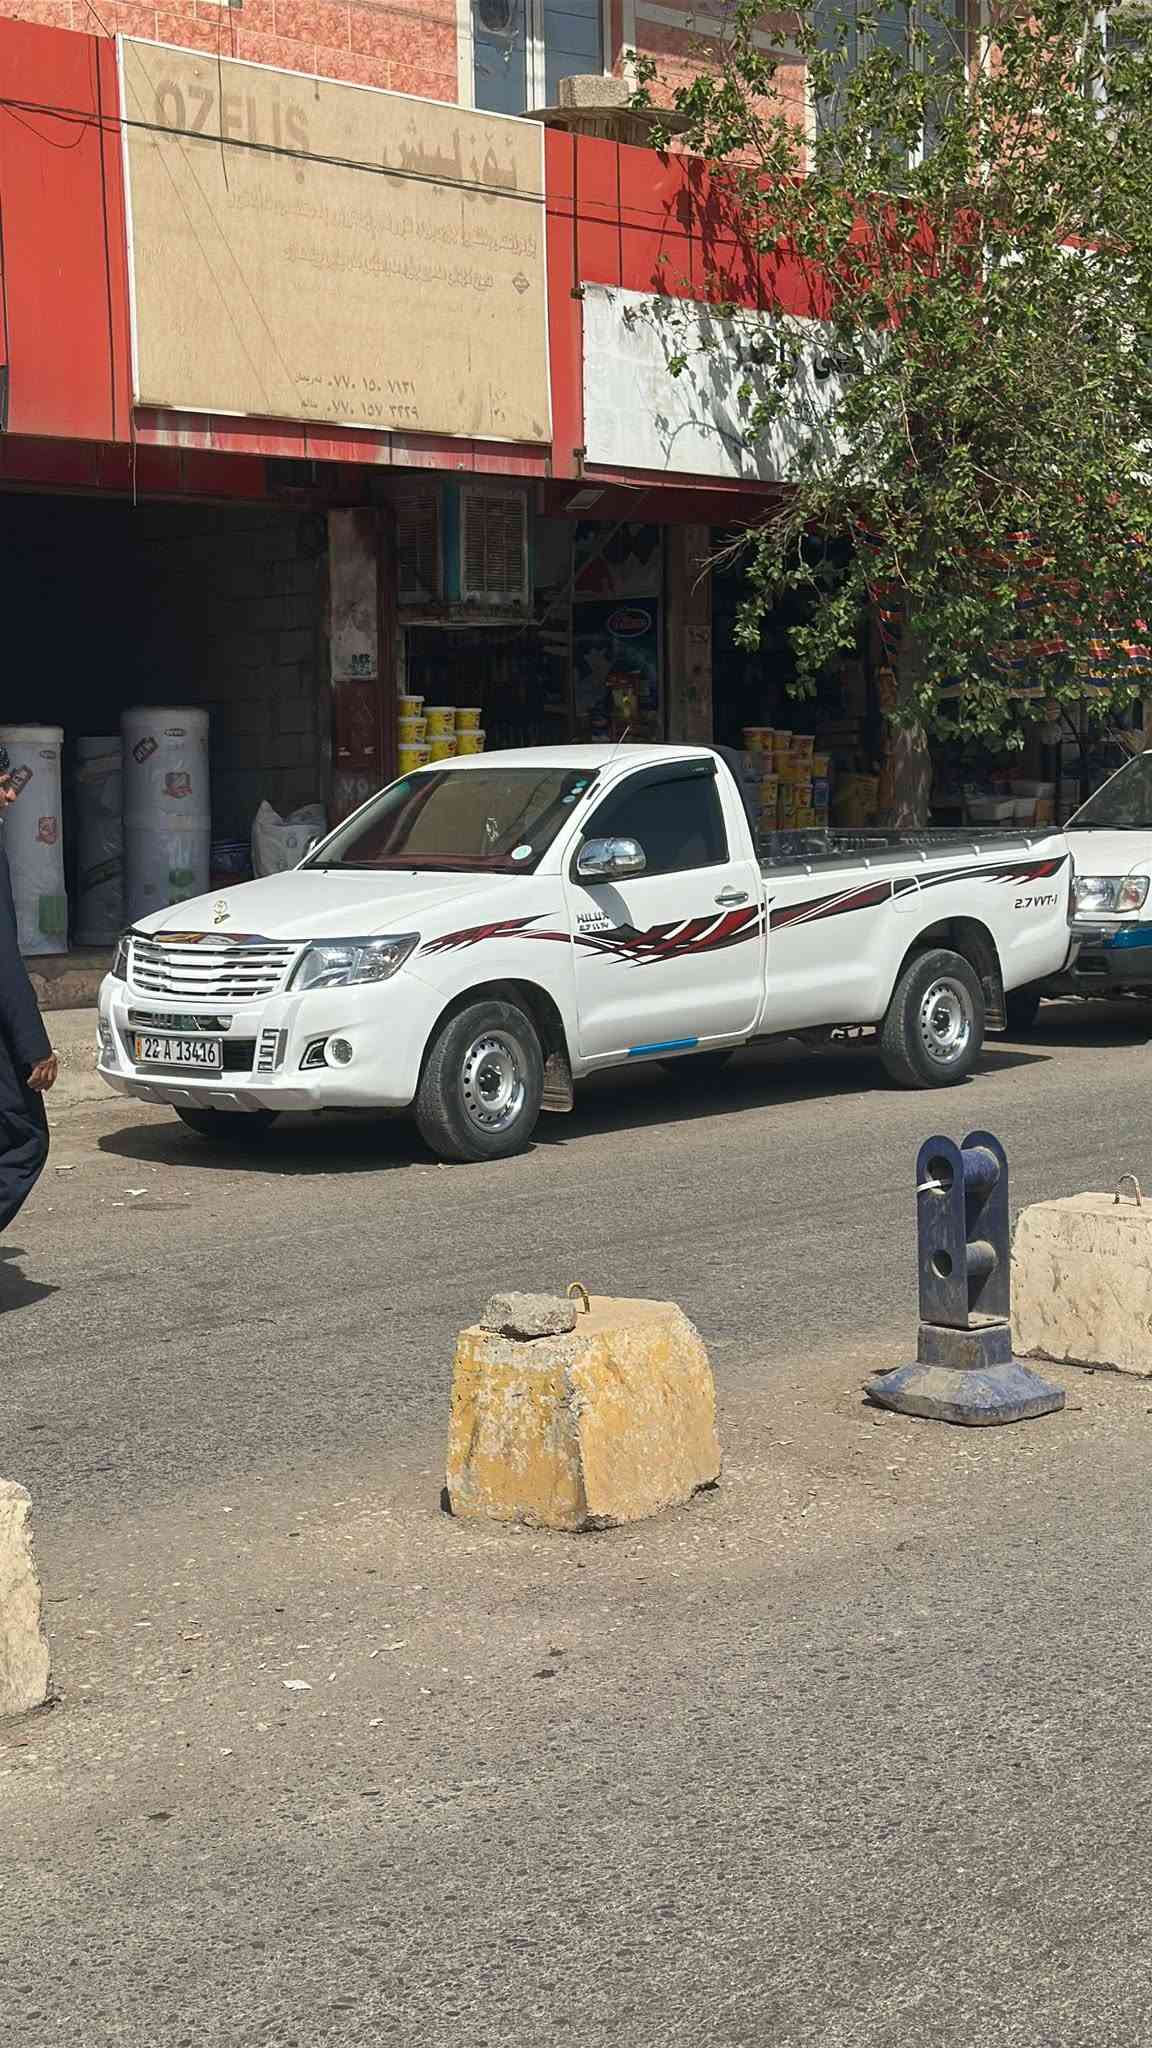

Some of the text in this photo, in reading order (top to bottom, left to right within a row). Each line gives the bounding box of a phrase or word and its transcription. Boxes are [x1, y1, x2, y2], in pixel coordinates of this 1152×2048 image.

[577, 911, 609, 923] HILUX
[144, 1038, 160, 1058] 22
[164, 1040, 172, 1060] A
[176, 1041, 216, 1063] 13416
